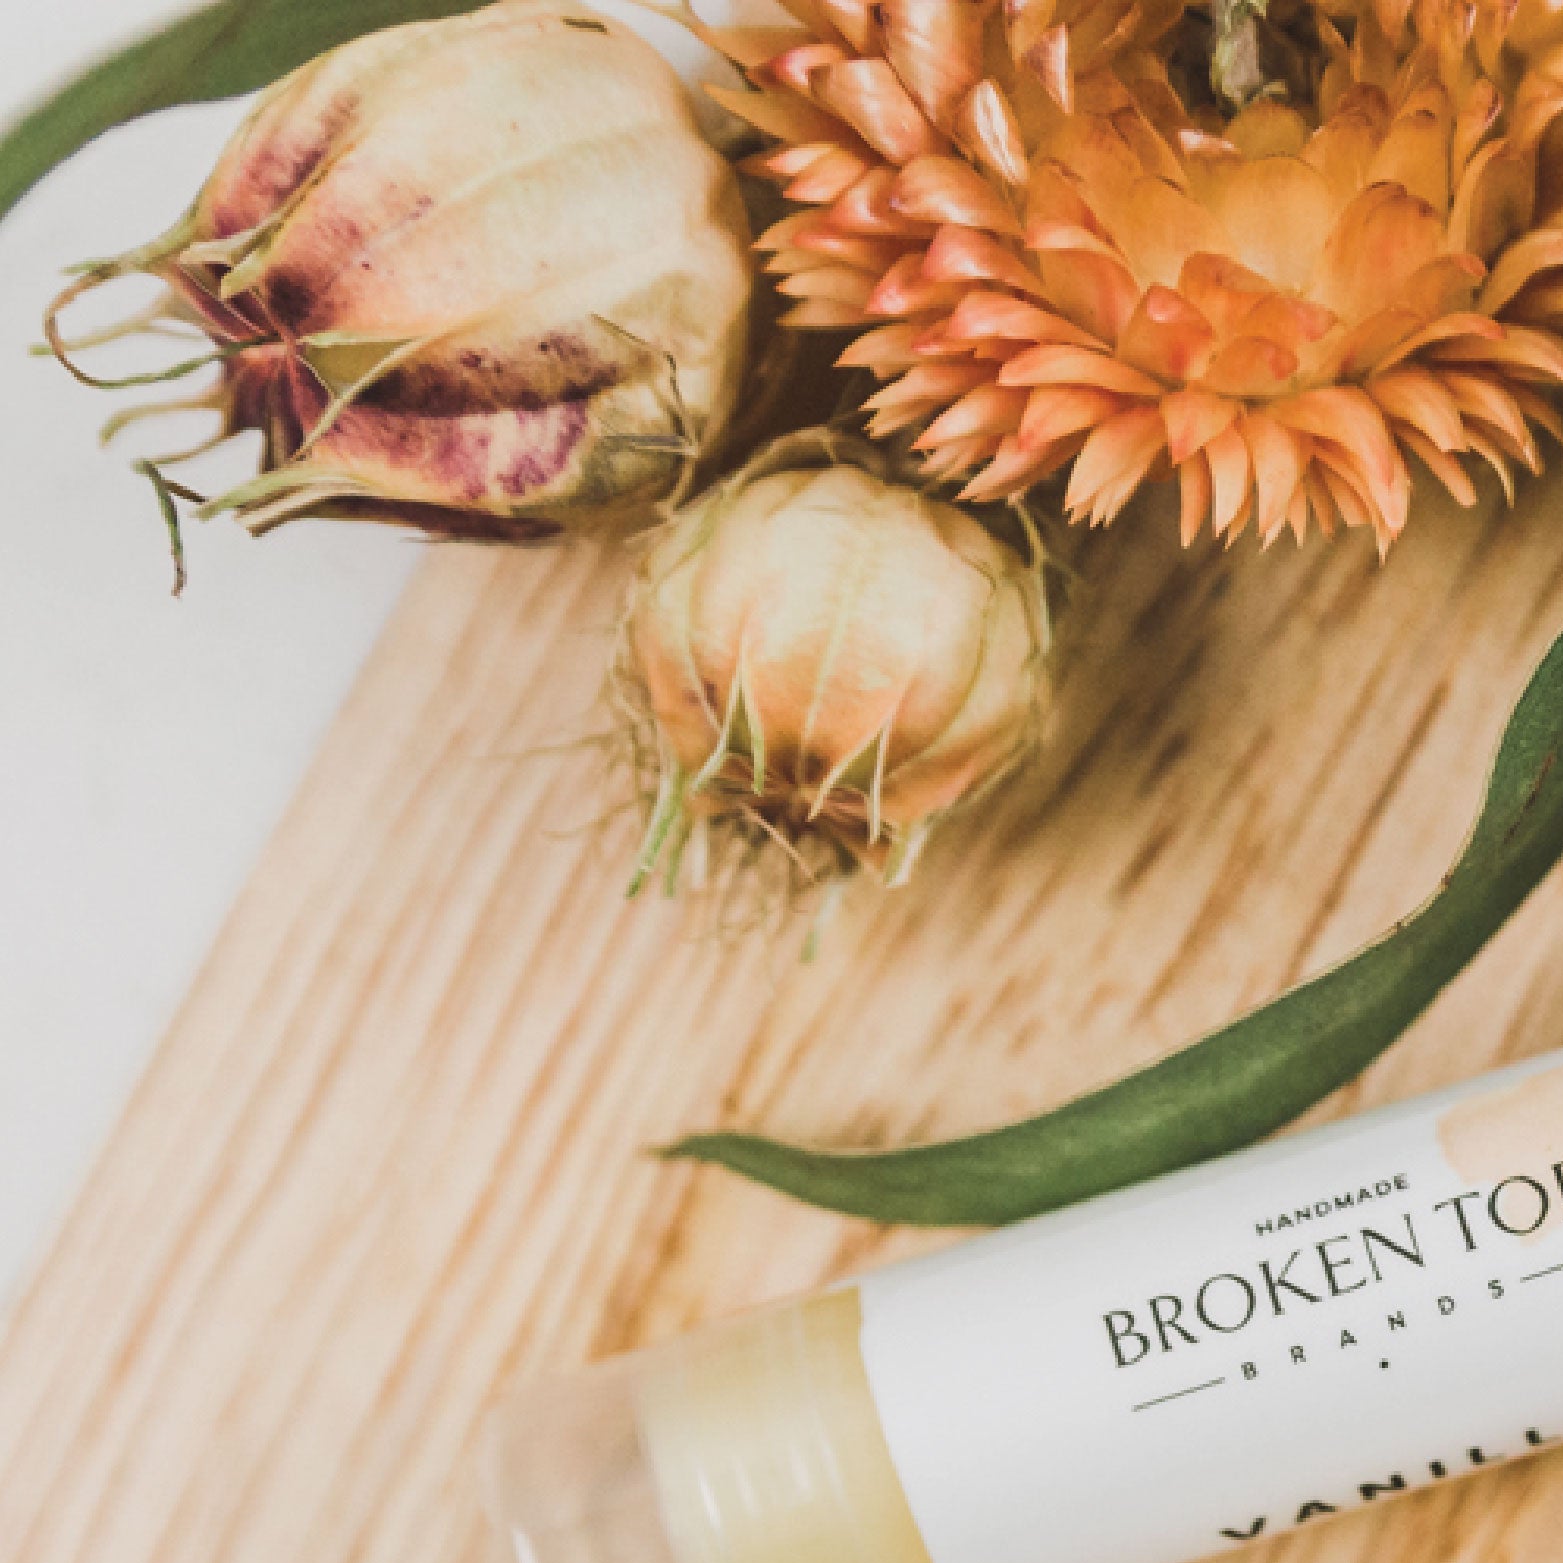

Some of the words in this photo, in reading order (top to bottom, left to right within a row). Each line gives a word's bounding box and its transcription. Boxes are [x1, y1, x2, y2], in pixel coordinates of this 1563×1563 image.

[1254, 1172, 1409, 1237] HANDMADE
[1102, 1213, 1425, 1368] BROKEN
[1240, 1278, 1505, 1381] BRANDS
